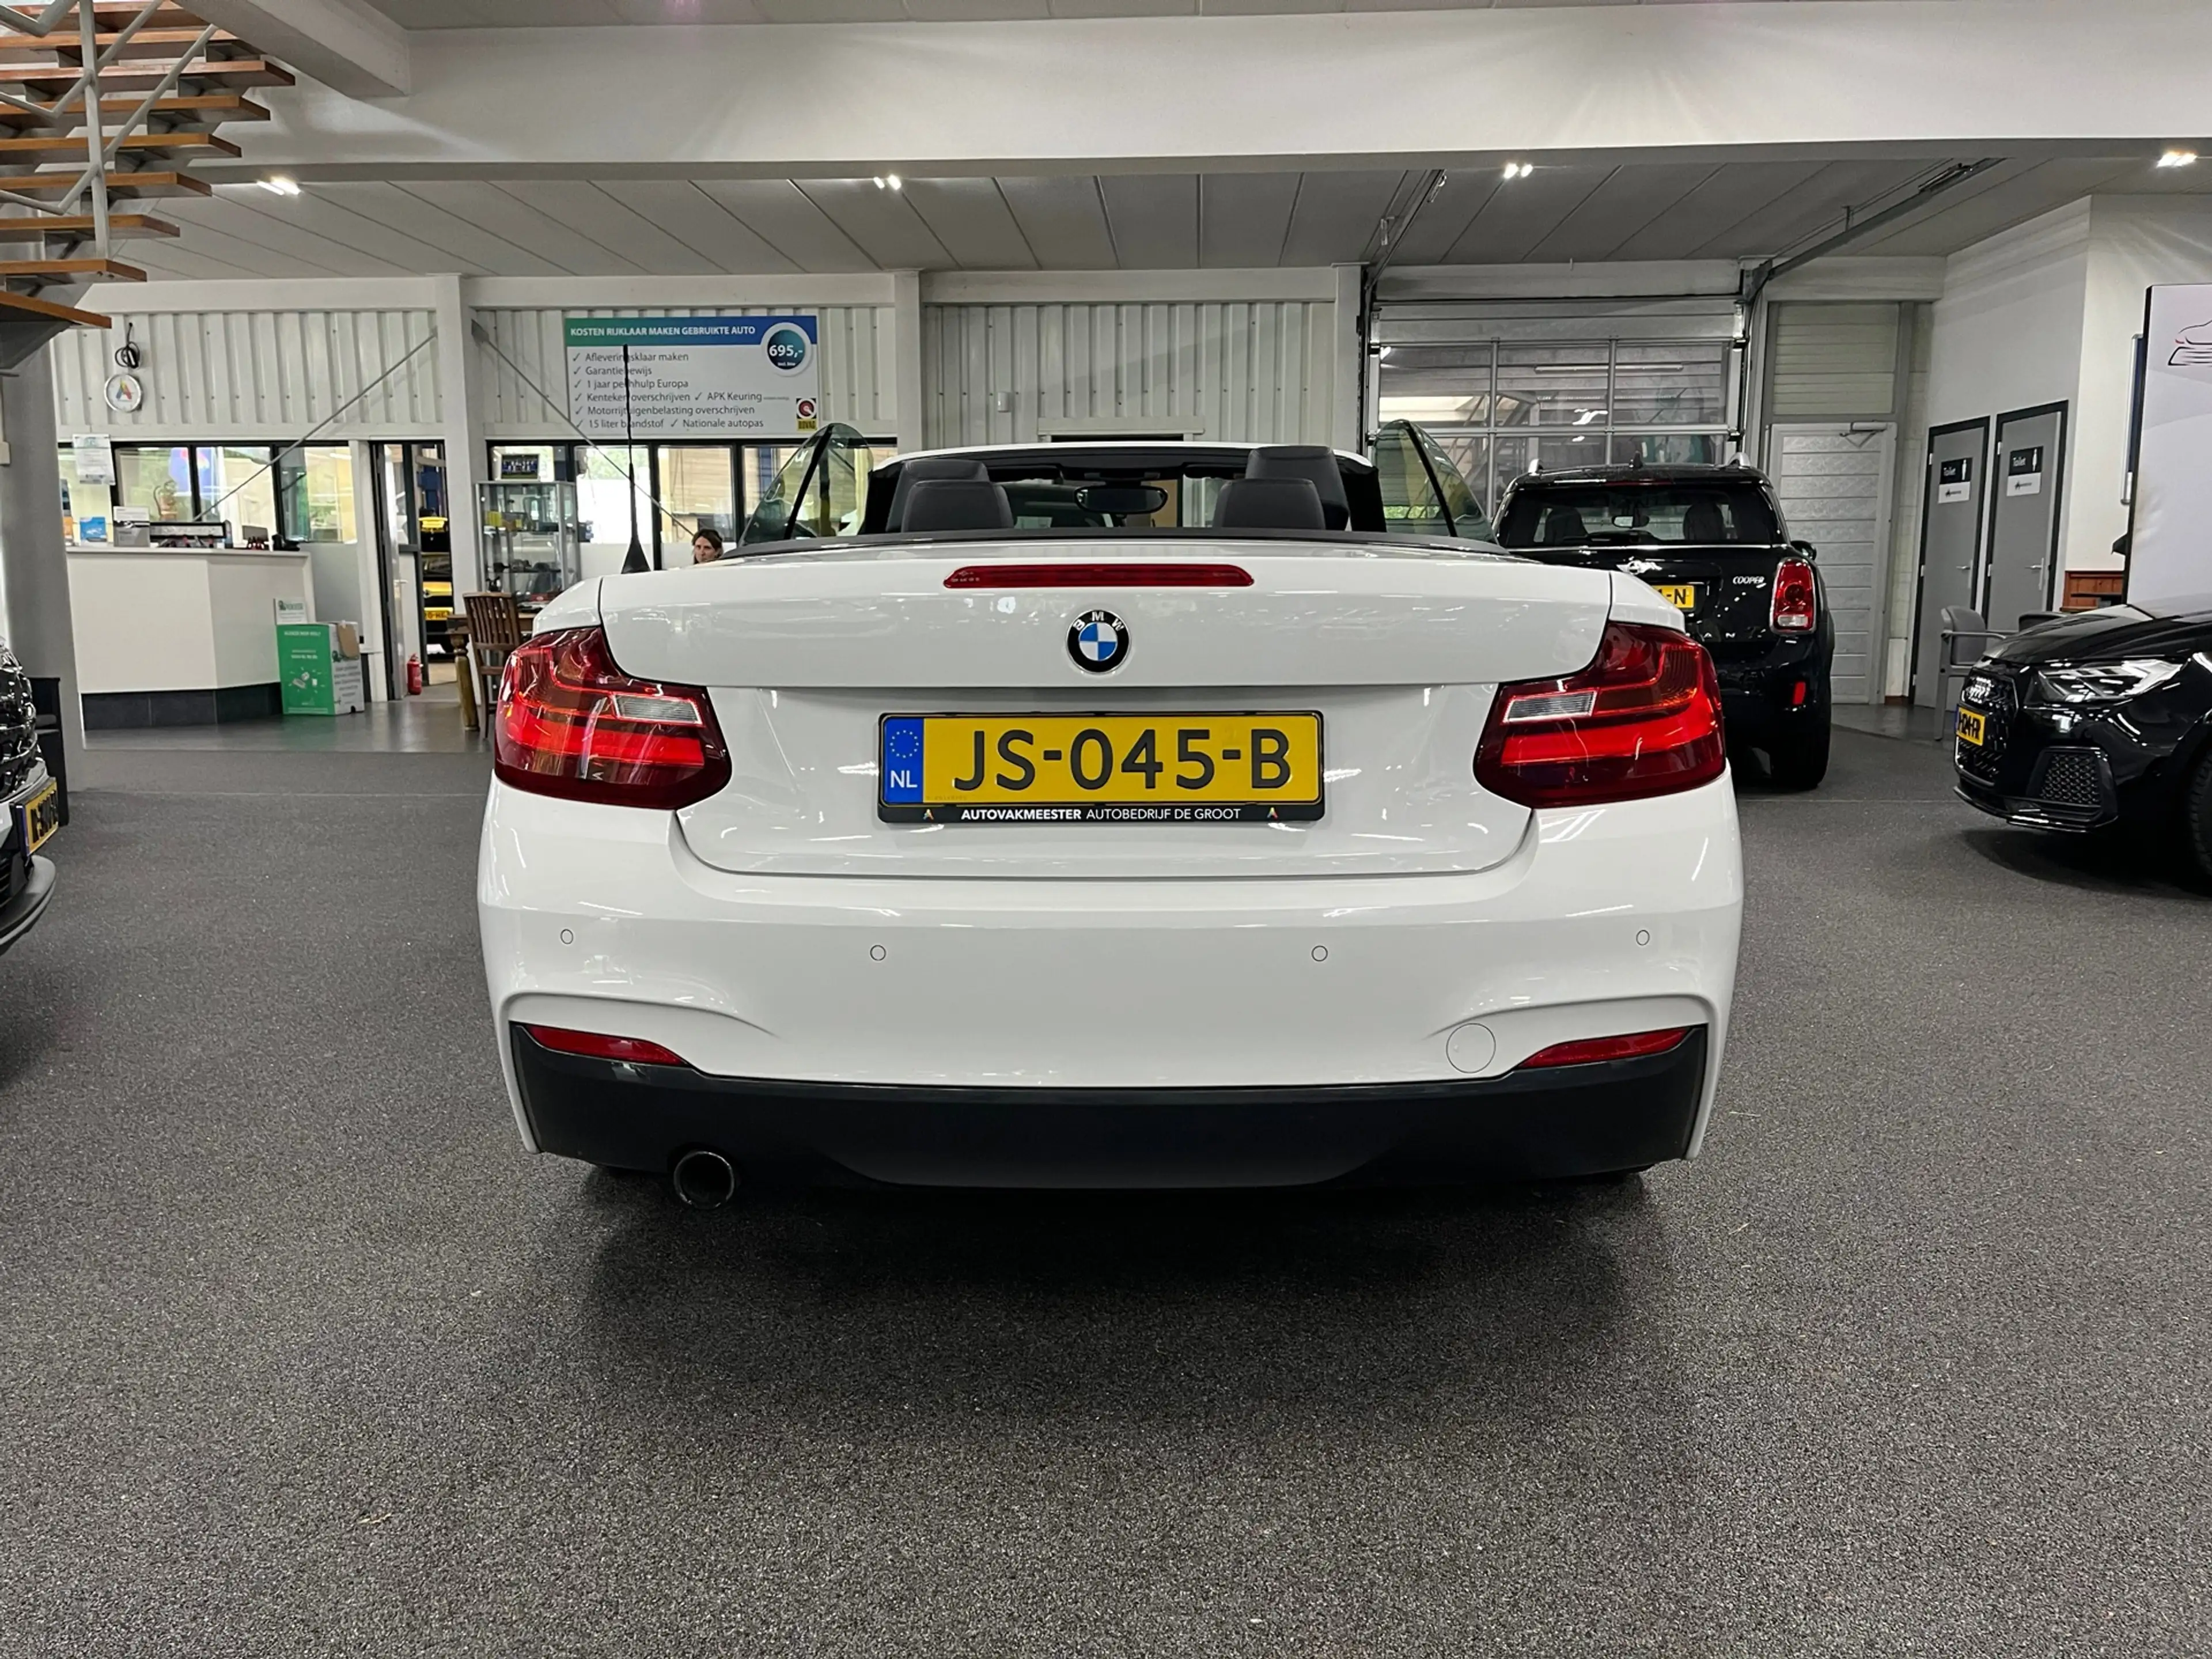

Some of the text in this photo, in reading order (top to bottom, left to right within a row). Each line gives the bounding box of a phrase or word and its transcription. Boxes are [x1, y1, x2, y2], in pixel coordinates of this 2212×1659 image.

[570, 326, 755, 336] KOSTEN RIJKLAAR MAKEN GEBRUIKTE AUTO
[769, 344, 803, 358] 695,-
[585, 353, 656, 362] Afleverinsklaar
[588, 379, 688, 389] 1 jaar pehhulp Europa
[631, 393, 690, 403] overschrijven
[707, 392, 726, 400] APK
[728, 392, 763, 402] Keuring
[695, 406, 755, 415] overschrijven
[589, 418, 764, 429] 15 liter bandstof Nationale autopas
[1073, 611, 1126, 631] BMW
[953, 728, 1292, 791] JS-045-B
[890, 770, 918, 788] NL
[961, 808, 1241, 820] AUTOVAKMEESTER AUTOBEDRIJF DE GROOT
